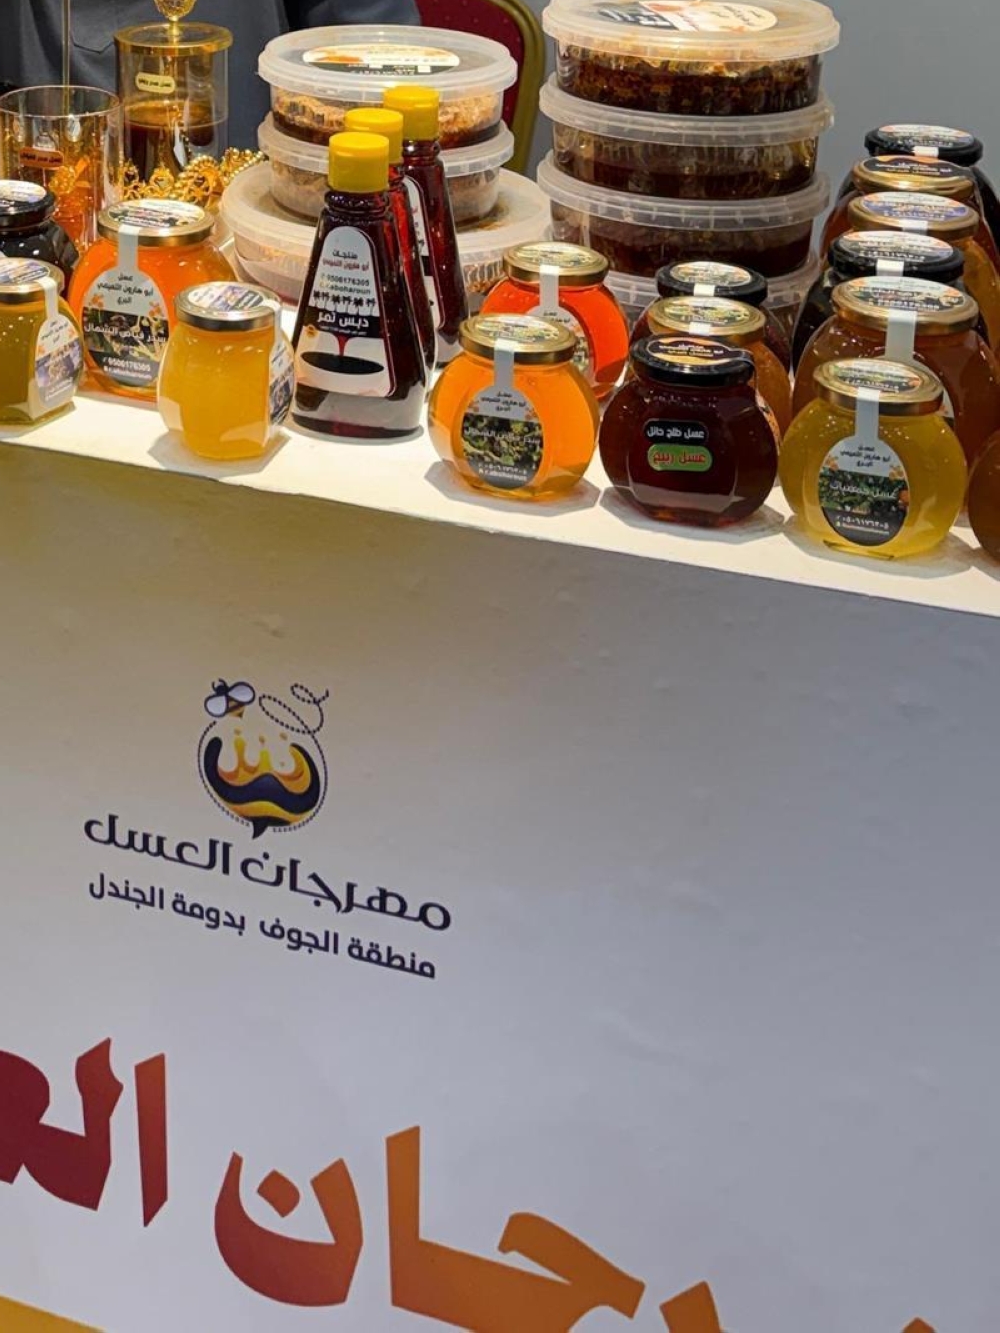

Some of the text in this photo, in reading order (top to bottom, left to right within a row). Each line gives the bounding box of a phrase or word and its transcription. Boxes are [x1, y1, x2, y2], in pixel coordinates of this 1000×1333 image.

[317, 311, 370, 329] دبس تمر
[84, 814, 451, 931] مهرجان العسل
[89, 873, 436, 979] منطقة الجوف بدومة الجندل
